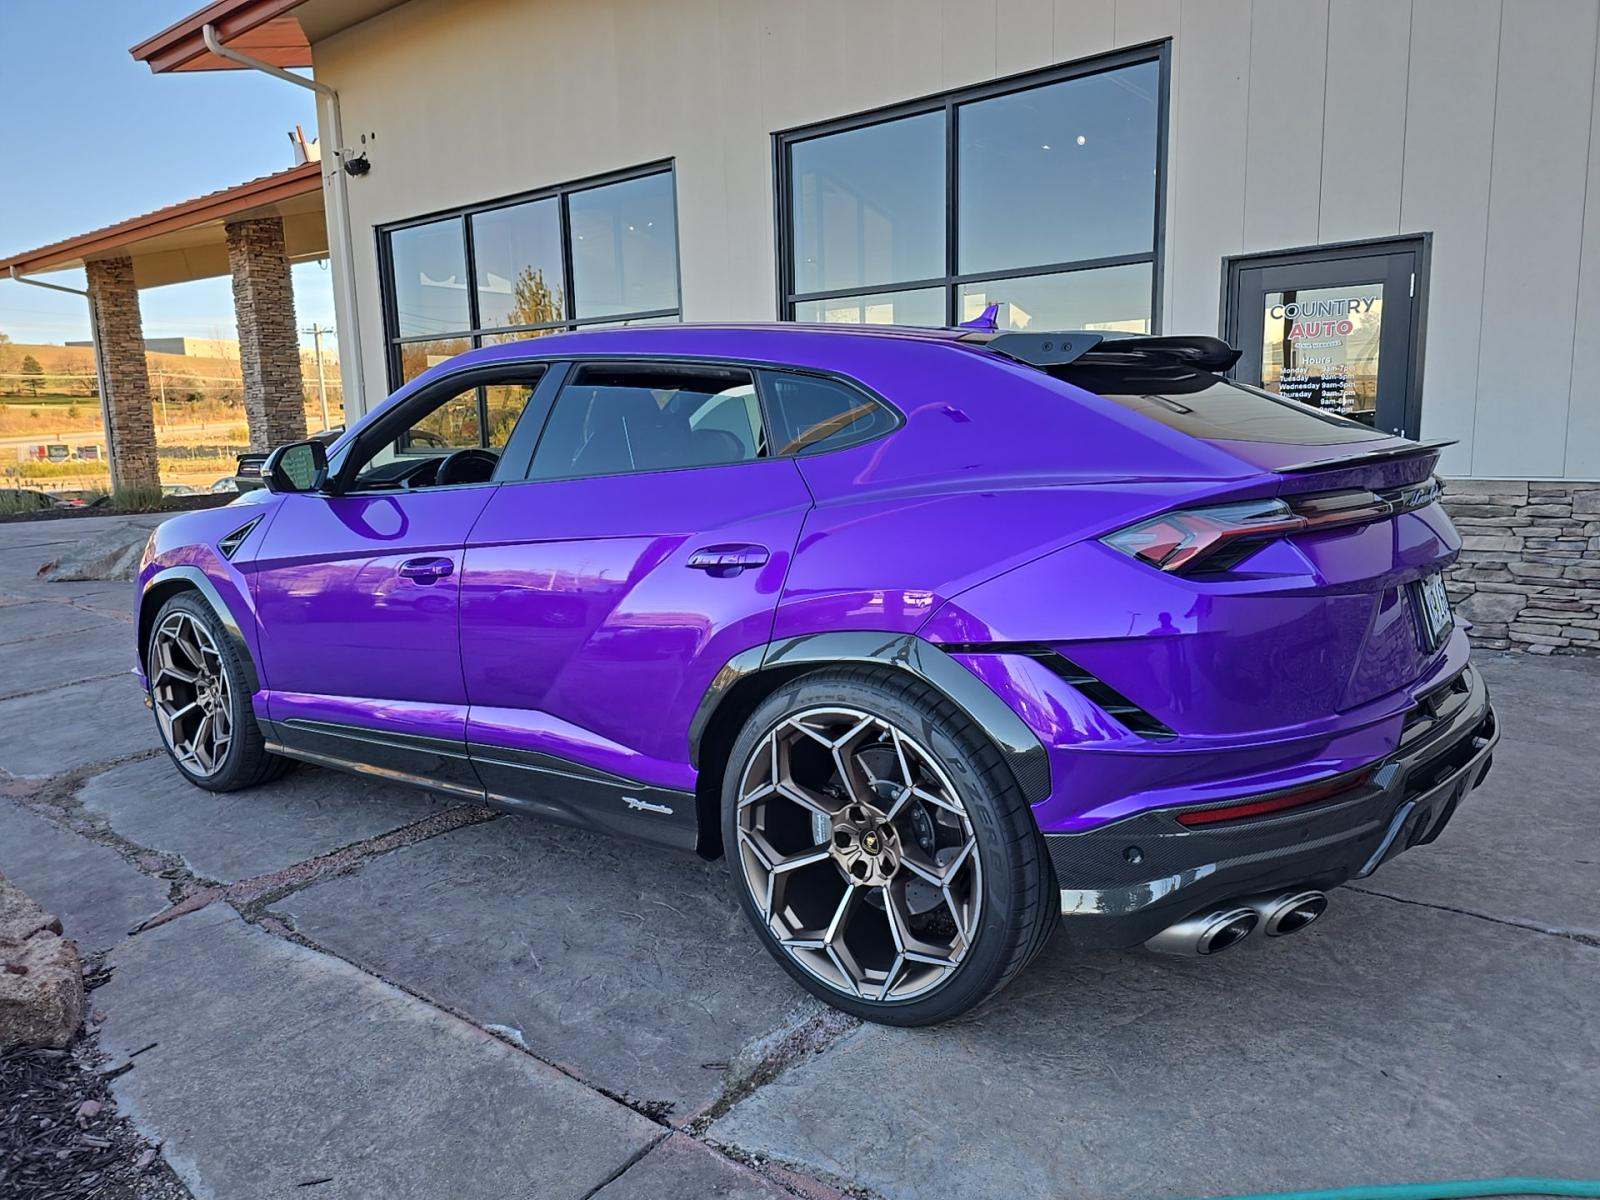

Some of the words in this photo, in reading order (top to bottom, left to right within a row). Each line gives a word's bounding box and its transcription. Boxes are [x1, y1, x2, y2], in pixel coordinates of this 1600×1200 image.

[1270, 296, 1376, 320] COUNTRY
[1288, 319, 1354, 340] AUTO
[1302, 356, 1331, 365] Hours
[1280, 367, 1309, 375] Monday
[1280, 375, 1309, 383] Tuesday
[1279, 383, 1321, 391] Wednesday
